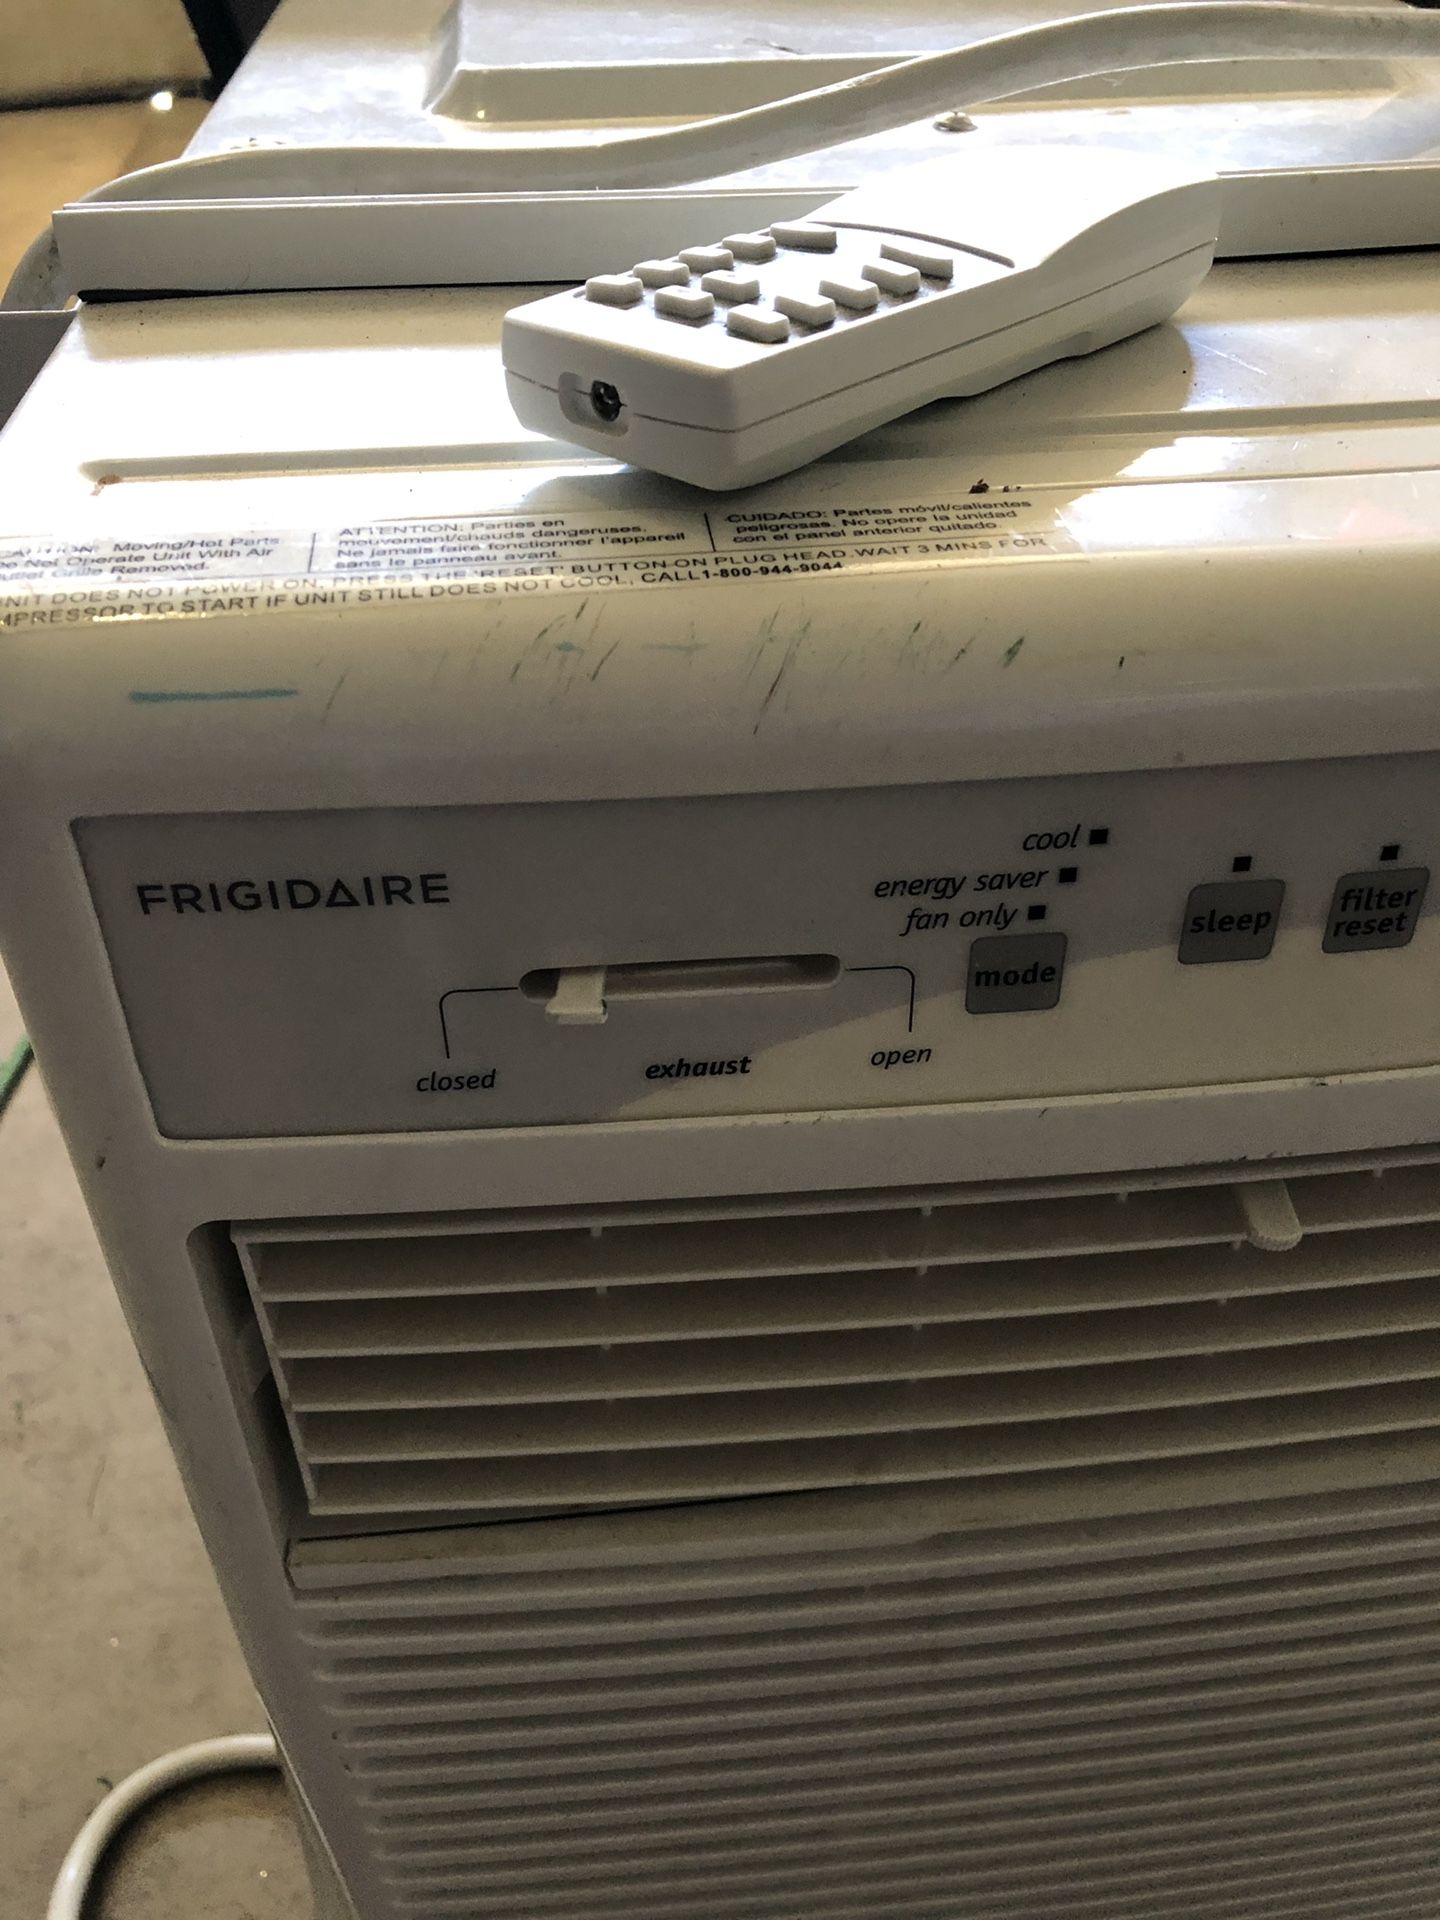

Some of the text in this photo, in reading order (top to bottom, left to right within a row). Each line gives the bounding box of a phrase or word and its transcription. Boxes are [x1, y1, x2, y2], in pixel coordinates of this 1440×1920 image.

[727, 500, 1033, 523] CUIDADO: Partes móvil/calientes
[736, 509, 1017, 534] peligrosas. No opere la unidad
[339, 519, 565, 536] ATTENTION: Parties en
[339, 530, 525, 546] mouvement/chauds
[733, 533, 766, 544] con
[773, 532, 789, 542] el
[796, 529, 846, 542] panel
[853, 523, 922, 537] anterior
[113, 538, 223, 553] Moving/Hot
[230, 537, 279, 547] Parts
[337, 532, 685, 558] Ne jamais faire fonctionner l'appareil
[24, 558, 58, 569] Not
[67, 553, 145, 567] Operate
[152, 551, 191, 561] Unit
[199, 549, 241, 559] With
[247, 547, 273, 557] Air
[51, 590, 119, 604] DOES
[127, 586, 174, 599] NOT
[333, 573, 413, 586] PRESS
[424, 570, 467, 582] THE
[715, 553, 776, 565] PLUG
[855, 545, 910, 558] WAIT
[918, 544, 930, 554] 3
[936, 540, 993, 553] MINS
[999, 537, 1048, 550] FOR
[111, 562, 209, 574] Removed.
[335, 551, 562, 569] sans le panneau avant.
[142, 601, 174, 615] TO
[181, 596, 262, 613] START
[267, 594, 288, 608] IF
[295, 591, 351, 606] UNIT
[358, 587, 423, 602] STILL
[430, 582, 496, 598] DOES
[505, 579, 551, 593] NOT
[1022, 824, 1081, 851] cool
[136, 873, 450, 915] FRIGIDAIRE
[874, 868, 1049, 899] energy saver
[1340, 887, 1419, 912] filter
[899, 902, 1018, 936] fan only
[1190, 909, 1272, 936] sleep
[1332, 912, 1408, 937] reset
[974, 961, 1056, 987] mode
[645, 1055, 752, 1079] exhaust
[870, 1045, 932, 1070] open
[416, 1068, 497, 1092] closed
